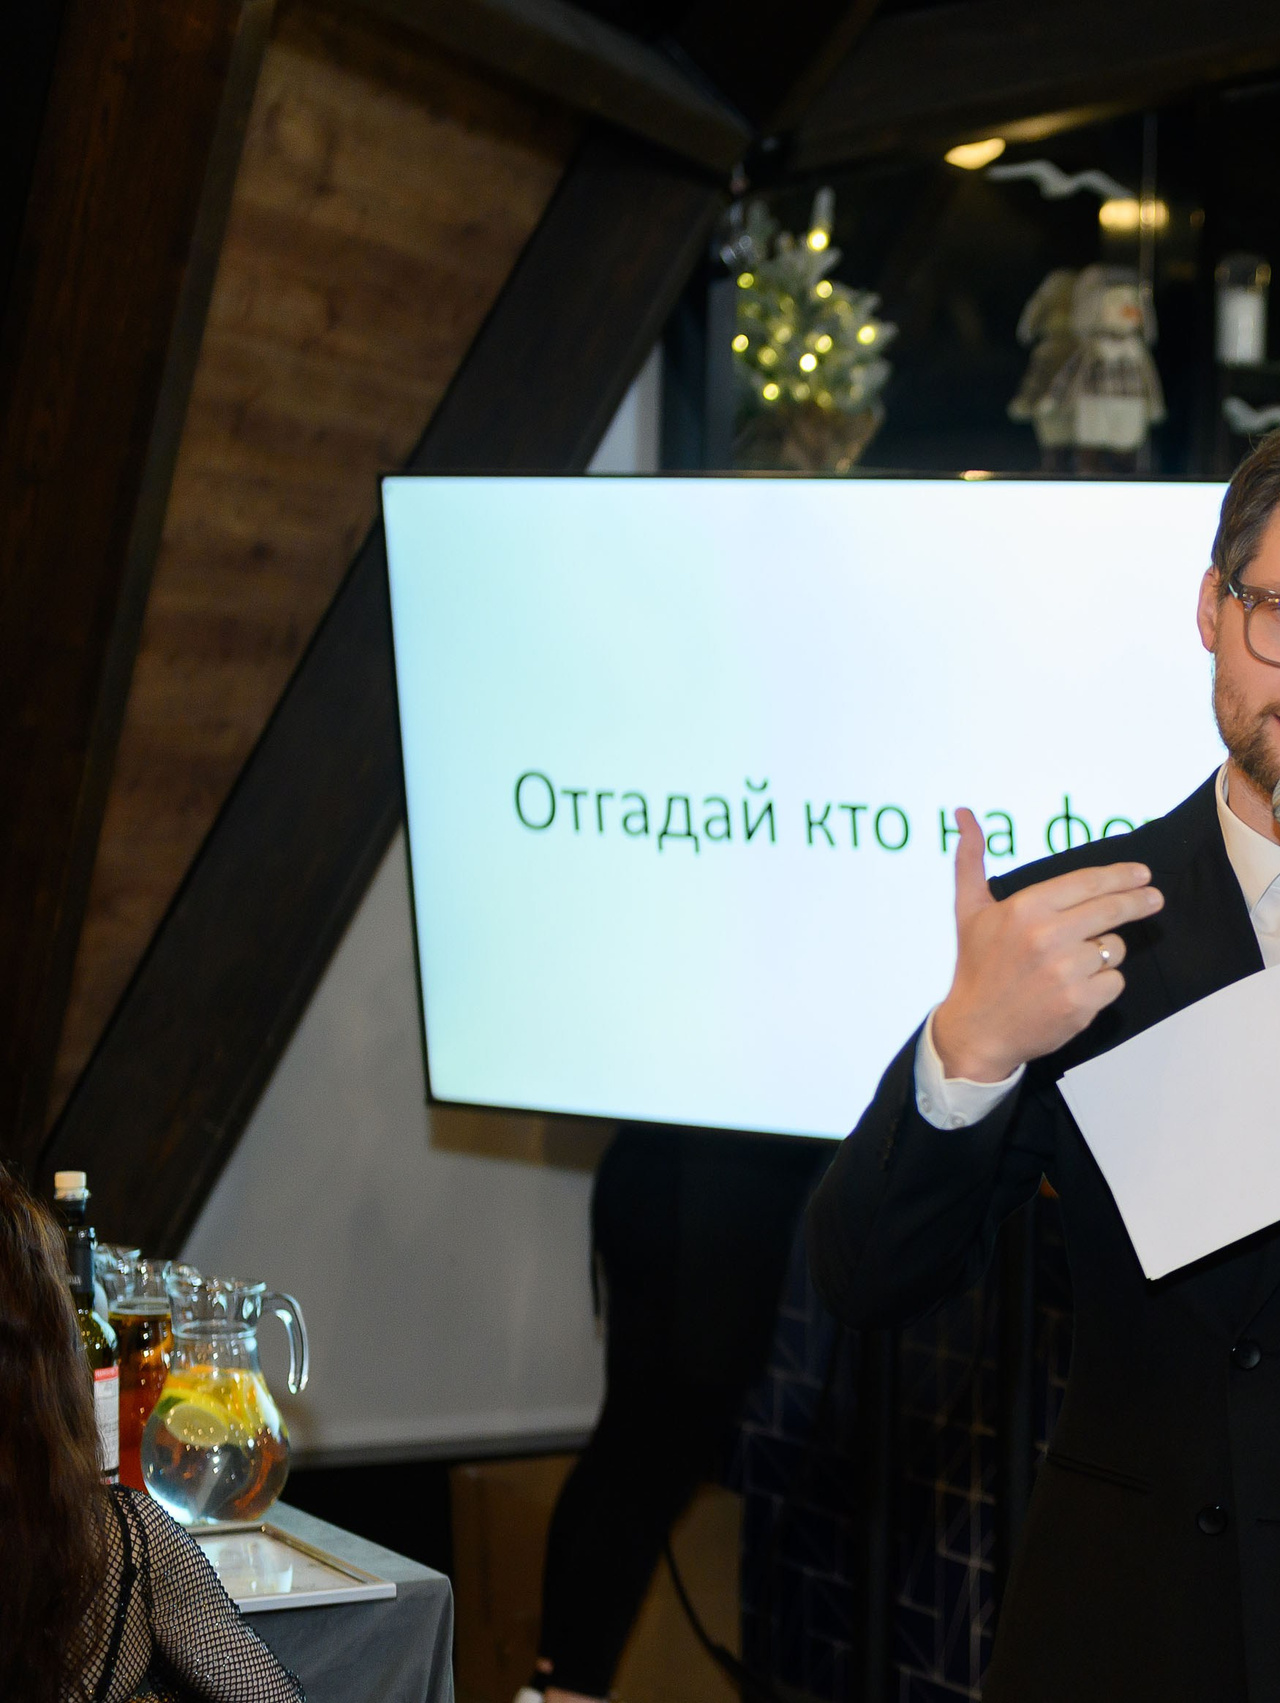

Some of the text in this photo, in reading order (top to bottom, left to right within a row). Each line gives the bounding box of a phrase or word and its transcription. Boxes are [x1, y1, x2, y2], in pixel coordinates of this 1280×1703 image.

[514, 771, 776, 854] Отгадай
[805, 802, 910, 851] кто
[940, 810, 1015, 857] на
